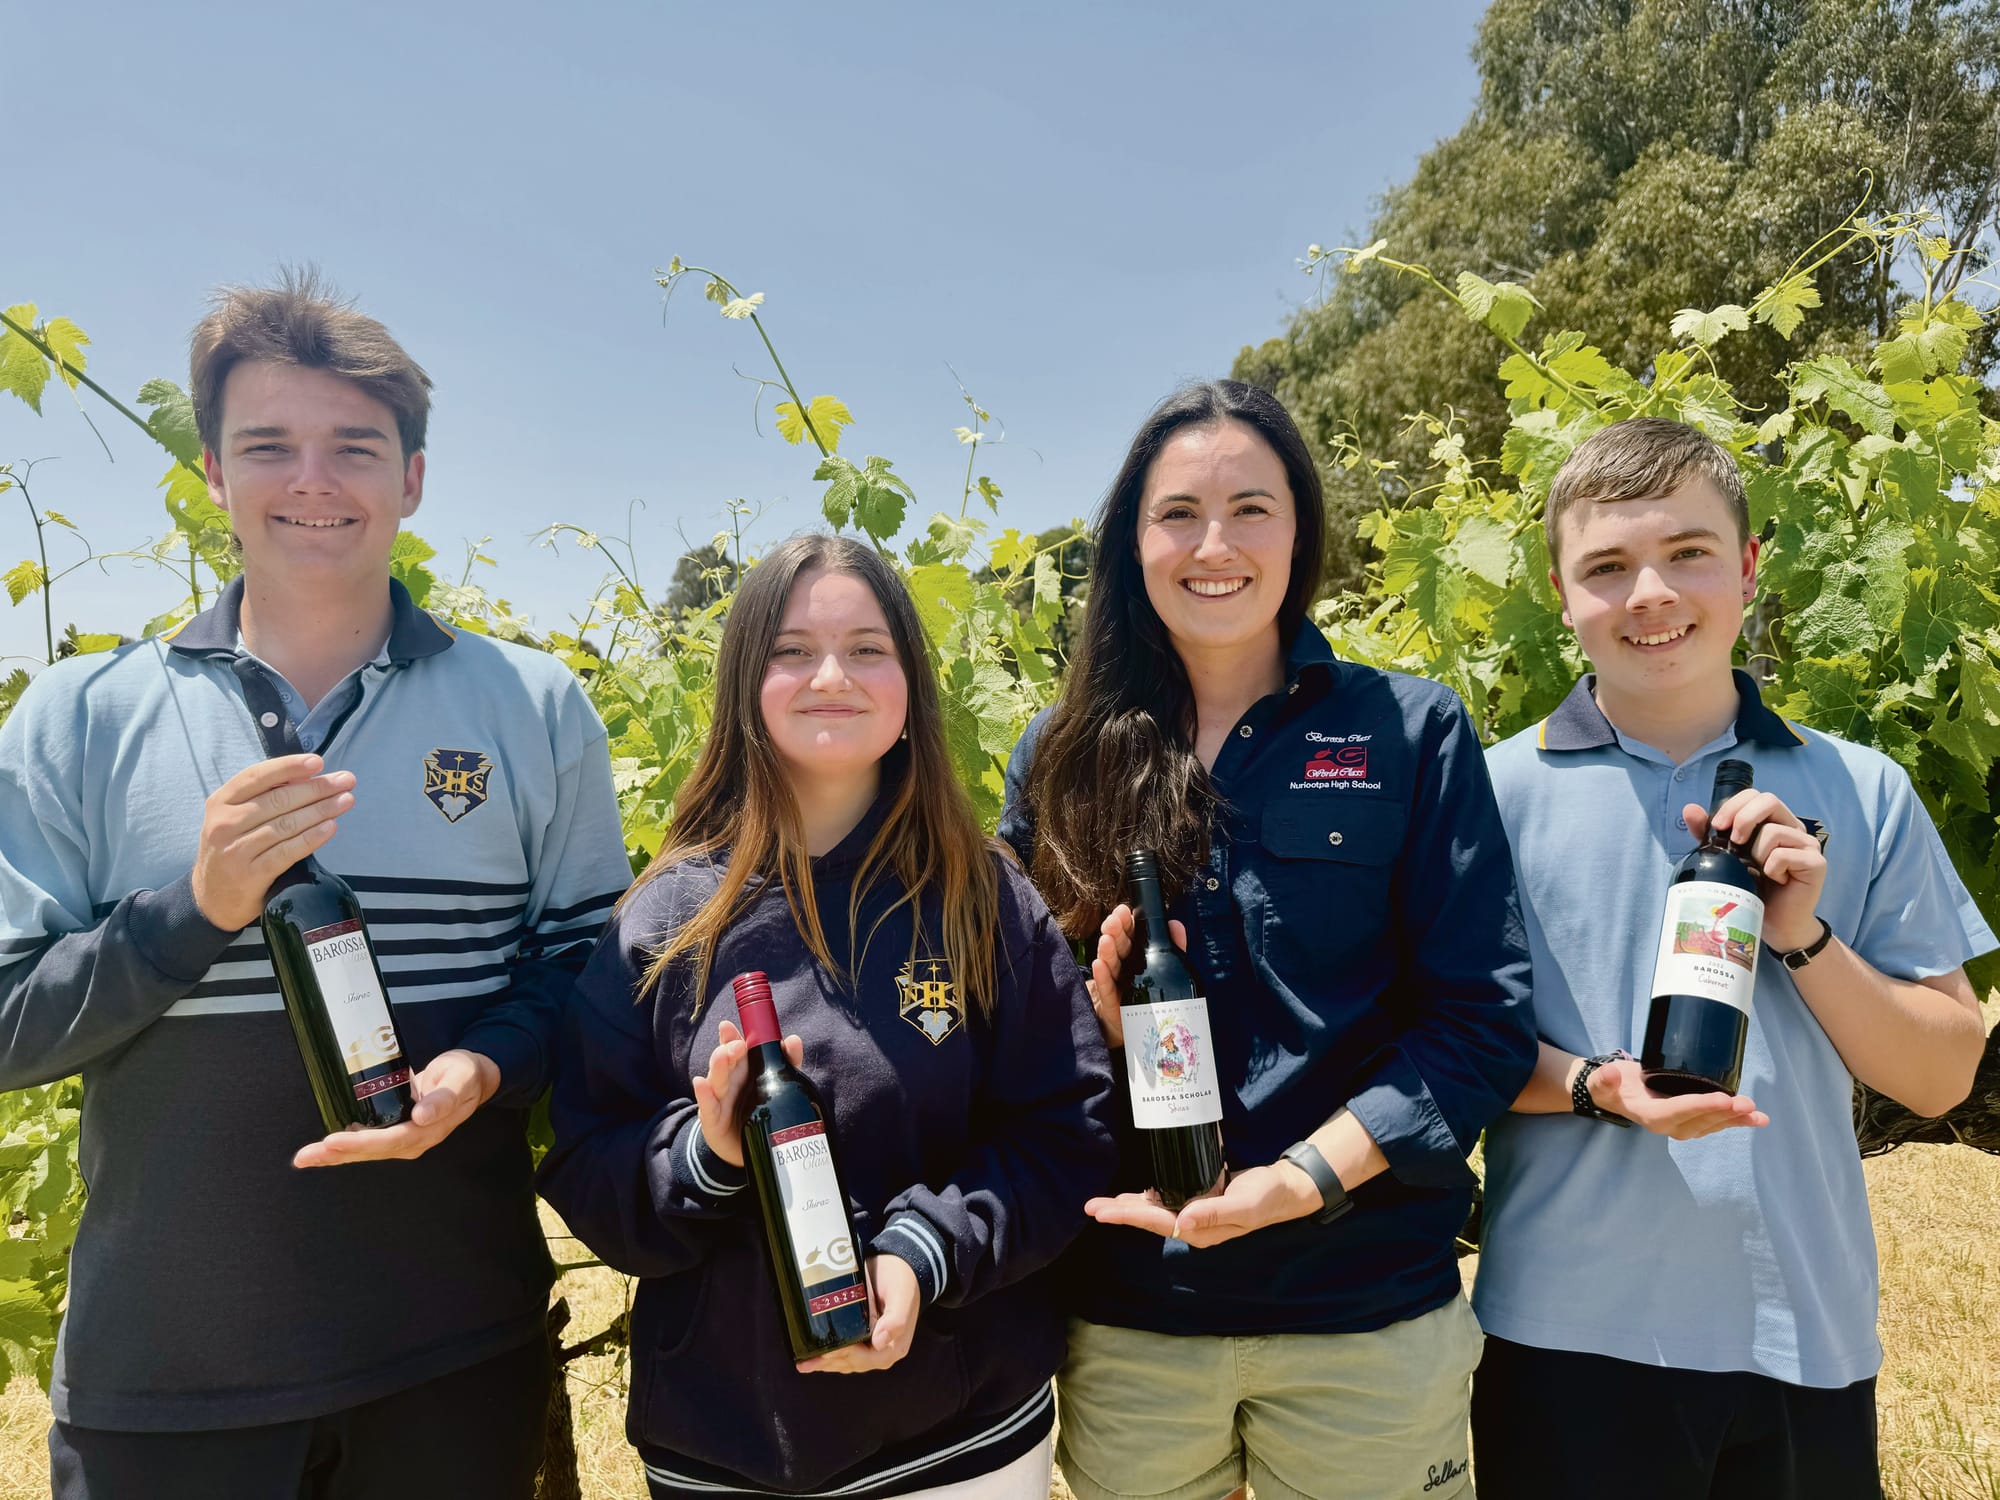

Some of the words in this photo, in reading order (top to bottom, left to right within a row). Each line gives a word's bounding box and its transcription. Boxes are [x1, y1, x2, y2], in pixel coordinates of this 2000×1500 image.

[1306, 767, 1338, 778] World
[1339, 767, 1364, 777] Class
[428, 769, 485, 793] NHS
[1289, 781, 1329, 790] Nuriootpa
[1330, 780, 1349, 790] High
[1351, 780, 1381, 790] School
[312, 936, 366, 963] BAROSSA
[1693, 965, 1735, 980] BAROSSA
[344, 991, 371, 1005] Shiraz
[371, 1074, 400, 1090] 2022
[1142, 1095, 1176, 1103] BAROSSA
[1179, 1089, 1212, 1100] SCHOLAR
[776, 1139, 828, 1167] BAROSSA
[801, 1198, 831, 1212] Shiraz
[825, 1290, 855, 1307] 2022
